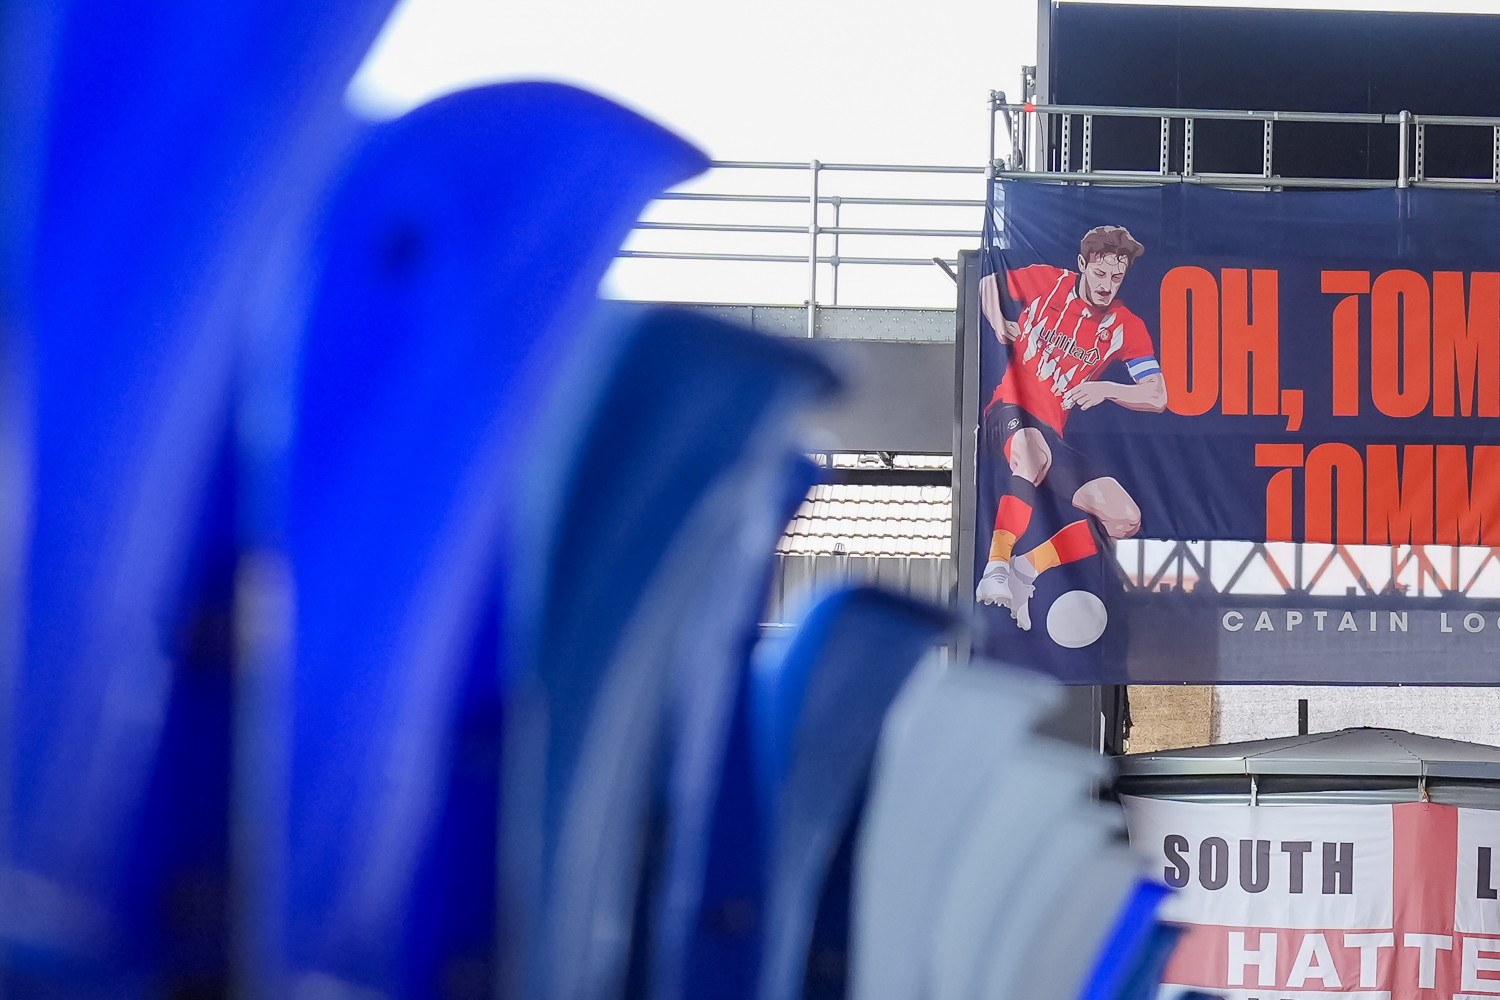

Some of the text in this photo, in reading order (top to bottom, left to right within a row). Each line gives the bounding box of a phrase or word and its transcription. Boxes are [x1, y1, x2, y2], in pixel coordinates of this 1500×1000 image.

[1039, 327, 1085, 360] utilita
[1160, 266, 1303, 431] OH,
[1222, 610, 1408, 632] CAPTAIN
[1164, 834, 1354, 895] SOUTH
